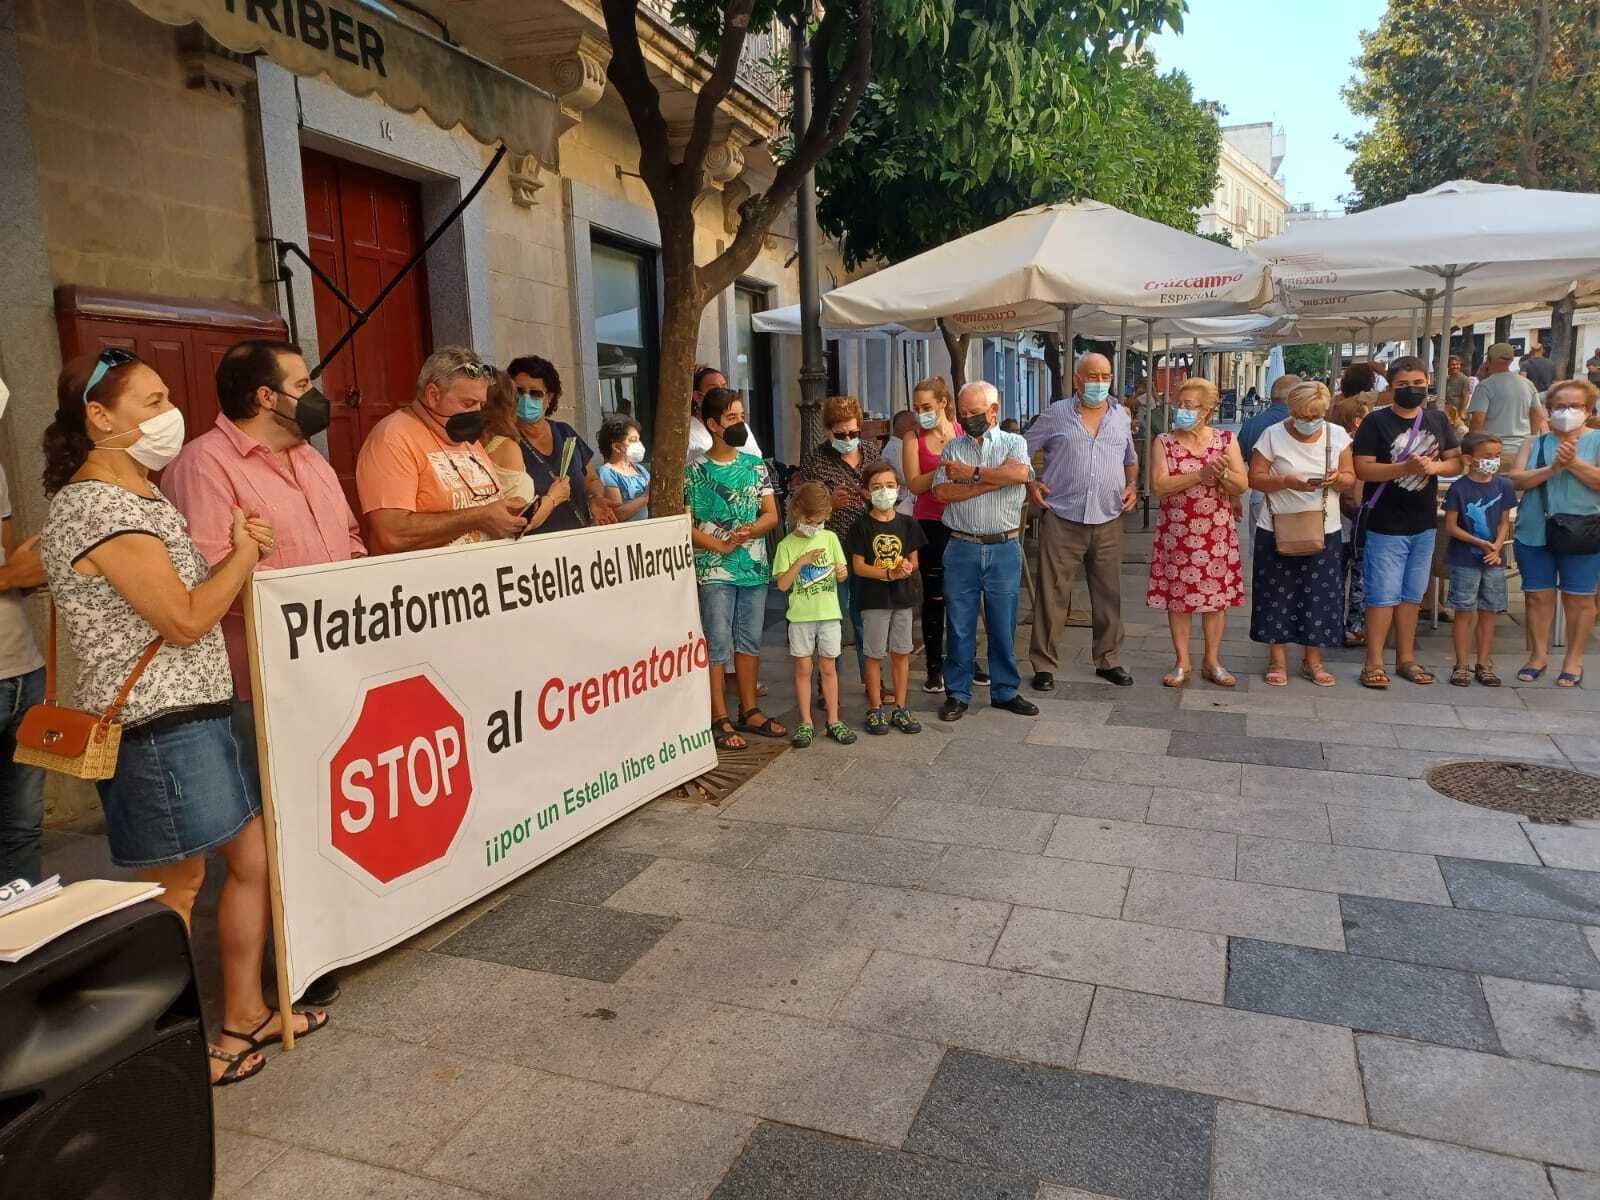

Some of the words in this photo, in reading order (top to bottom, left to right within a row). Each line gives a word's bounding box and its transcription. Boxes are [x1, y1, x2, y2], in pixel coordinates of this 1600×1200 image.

[226, 0, 387, 78] RIBER
[1143, 272, 1243, 291] Cruzcampo
[281, 583, 490, 660] Plataforma
[496, 556, 585, 612] Estella
[590, 547, 623, 591] del
[627, 534, 692, 581] Marqué
[487, 690, 523, 754] al
[537, 632, 710, 731] Crematorio
[340, 726, 461, 834] STOP
[537, 803, 560, 831] un
[563, 771, 619, 815] Estella
[622, 754, 656, 784] libre
[659, 742, 677, 765] de
